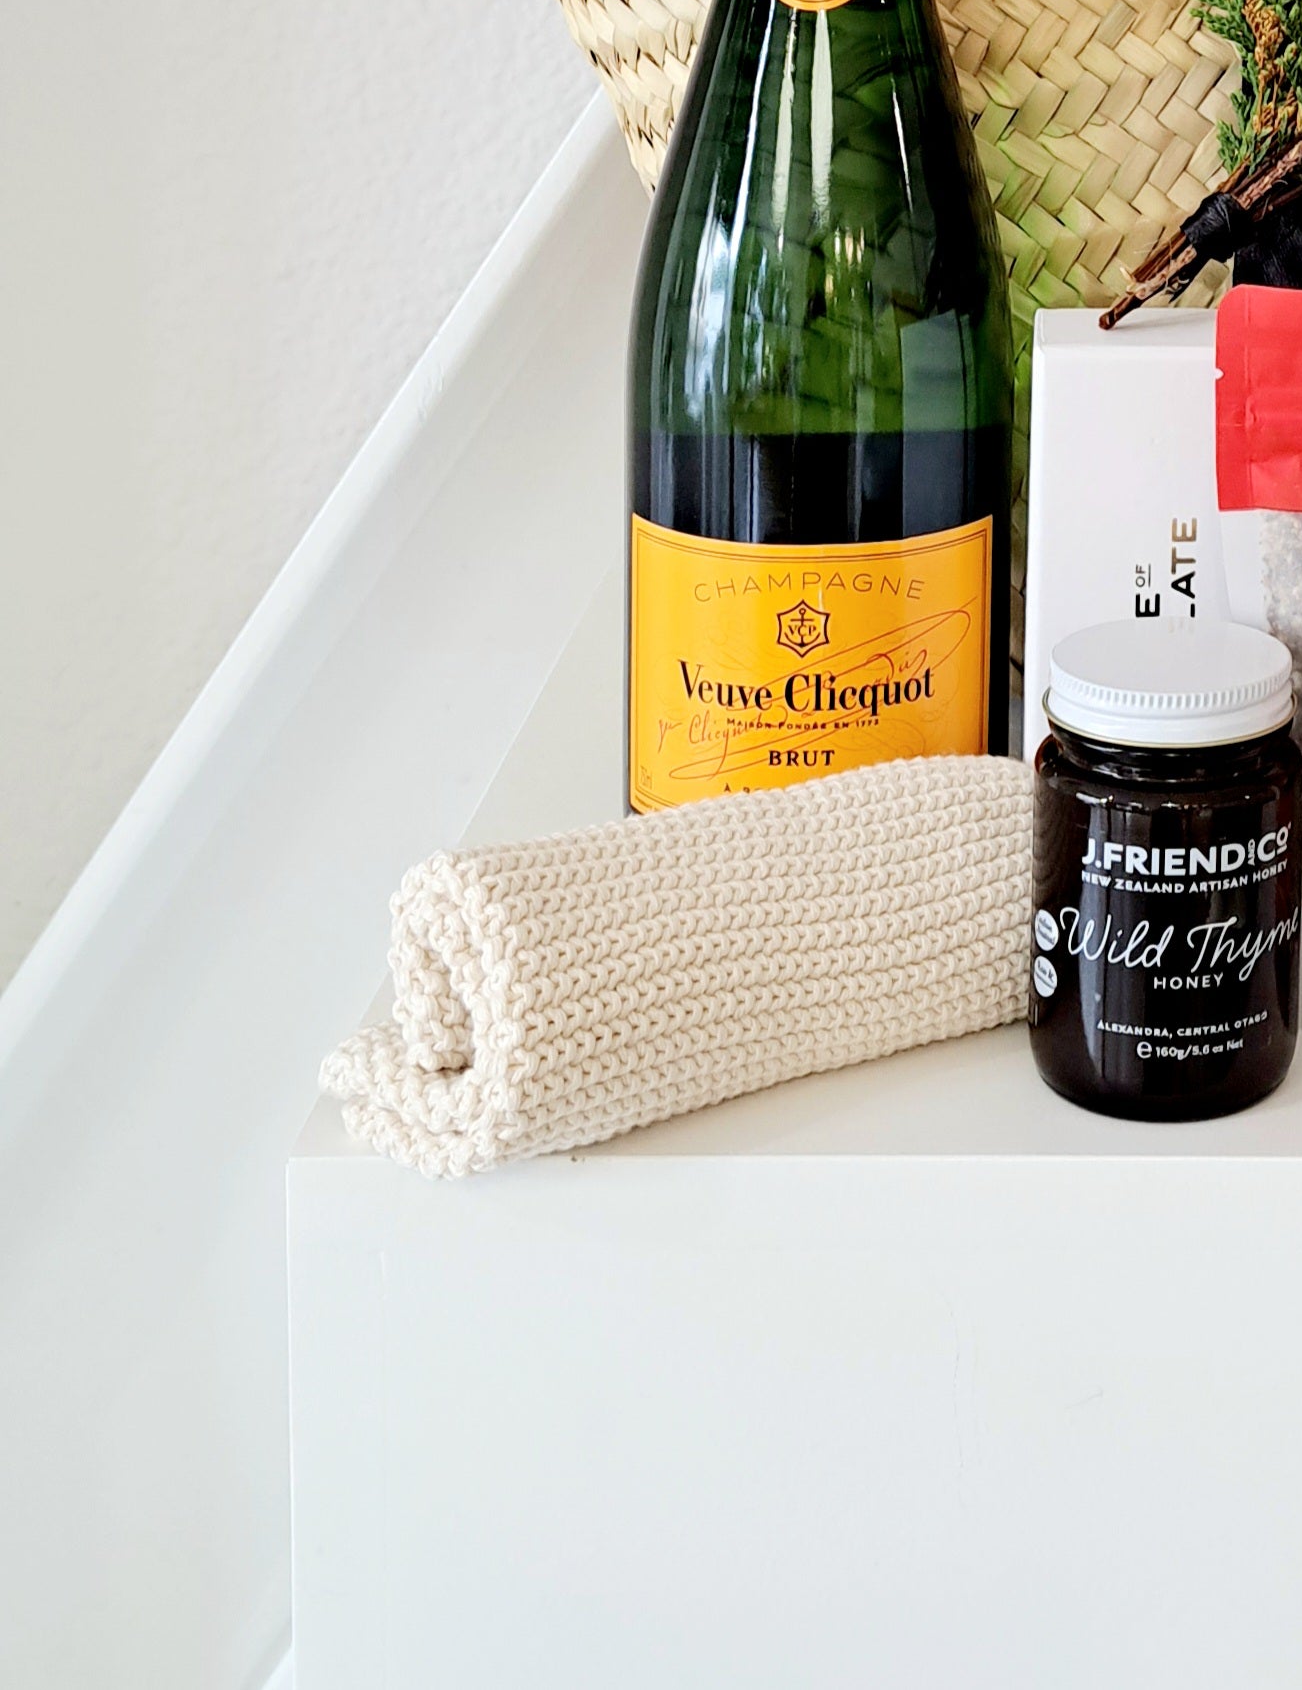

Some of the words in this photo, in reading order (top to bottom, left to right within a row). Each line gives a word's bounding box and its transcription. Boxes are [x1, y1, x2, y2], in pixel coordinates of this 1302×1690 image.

[694, 571, 926, 602] CHAMPAGNE
[1135, 564, 1146, 588] OF
[677, 659, 772, 711] Veuve
[784, 667, 936, 716] Clicquot
[769, 750, 835, 766] BRUT
[1081, 870, 1111, 887] NEW
[1114, 878, 1185, 894] ZEALAND
[1189, 875, 1249, 894] ARTISAN
[1252, 858, 1288, 883] HONEY
[1059, 906, 1175, 968] Wild
[1153, 972, 1224, 990] HONEY
[1097, 1019, 1173, 1039] ALEXANDRA,
[1177, 1022, 1231, 1037] CENTRAL
[1234, 1010, 1268, 1030] OTAGO
[1226, 1038, 1244, 1052] Net
